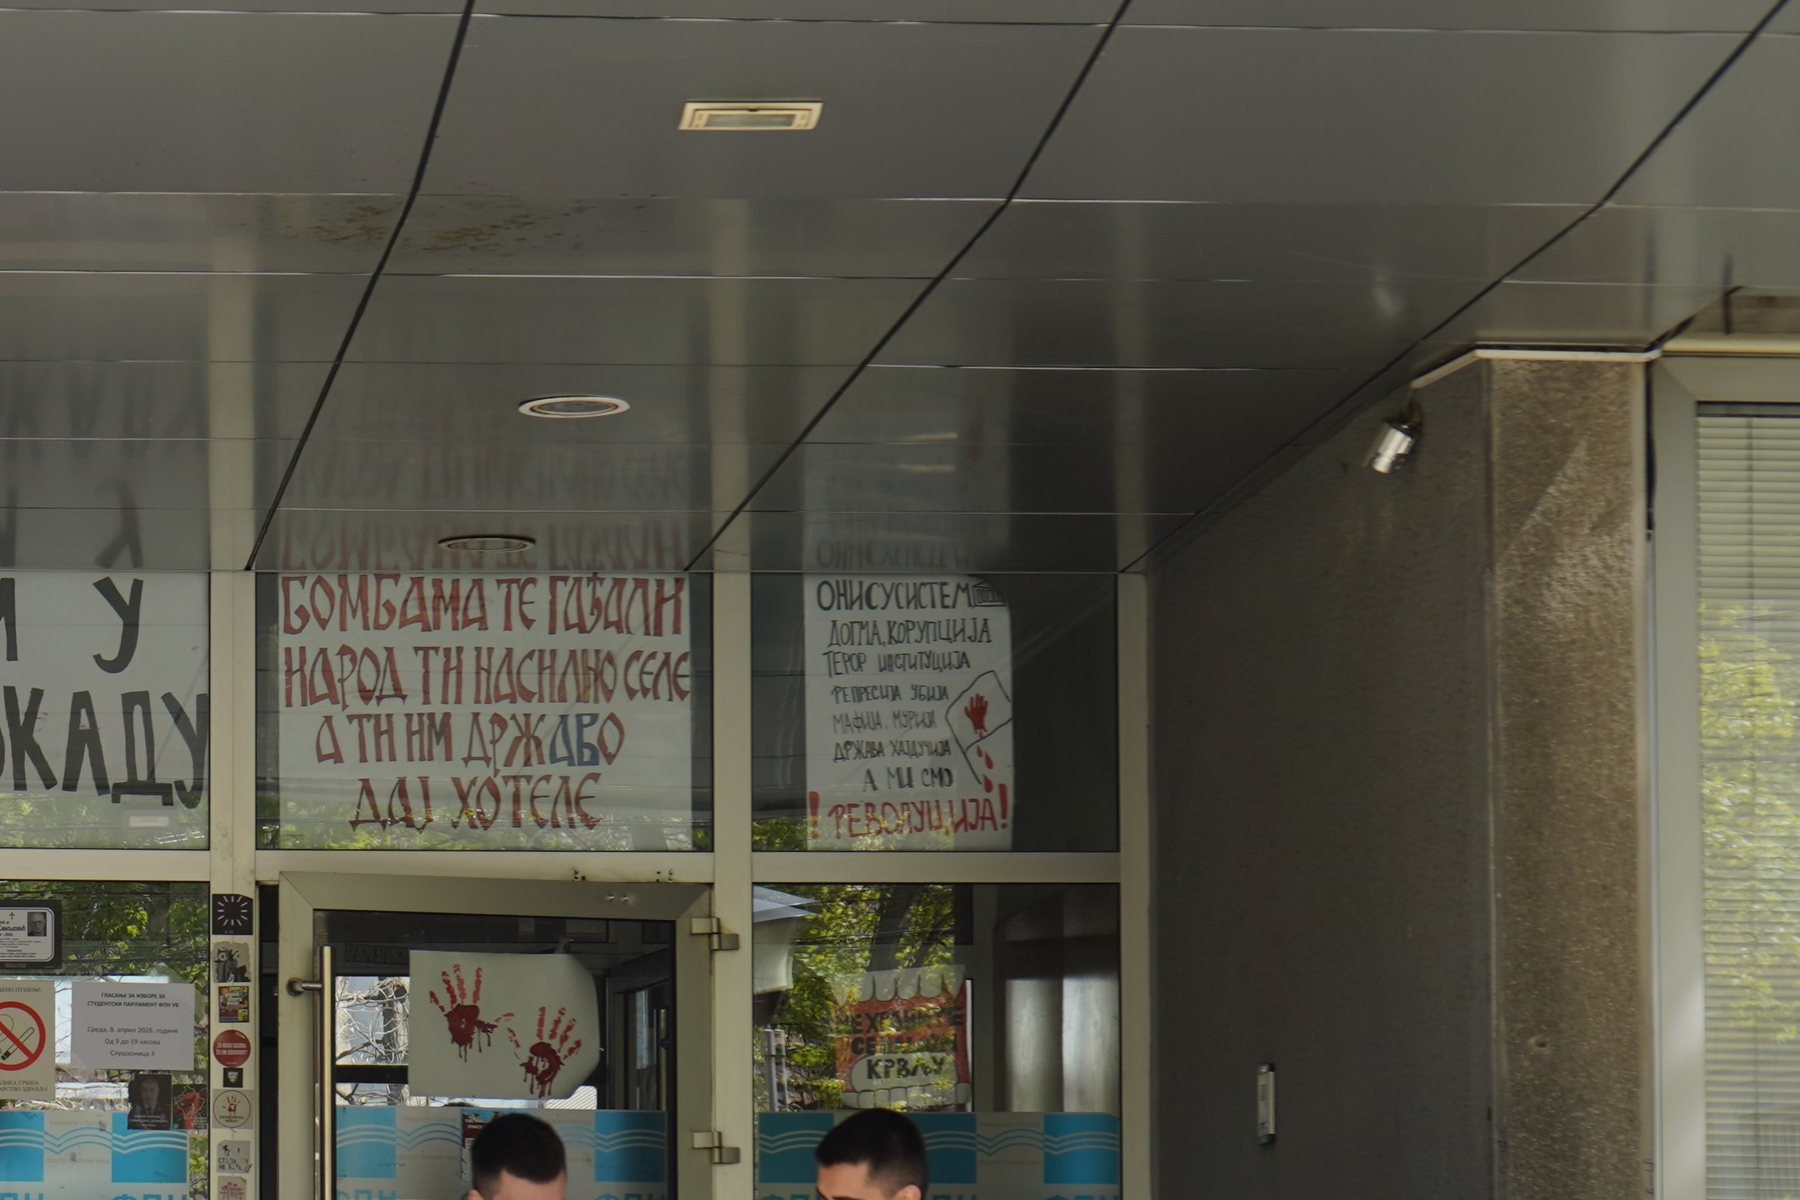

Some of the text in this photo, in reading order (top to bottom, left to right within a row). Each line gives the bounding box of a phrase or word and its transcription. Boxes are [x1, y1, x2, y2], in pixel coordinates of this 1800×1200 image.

[92, 576, 144, 674] У
[281, 573, 489, 636] БОМБАМА
[495, 576, 539, 632] ТЕ
[821, 650, 867, 678] ТЕРОР
[451, 772, 602, 831] ХОТЕЛЕ
[862, 766, 955, 792] А МИ СМО
